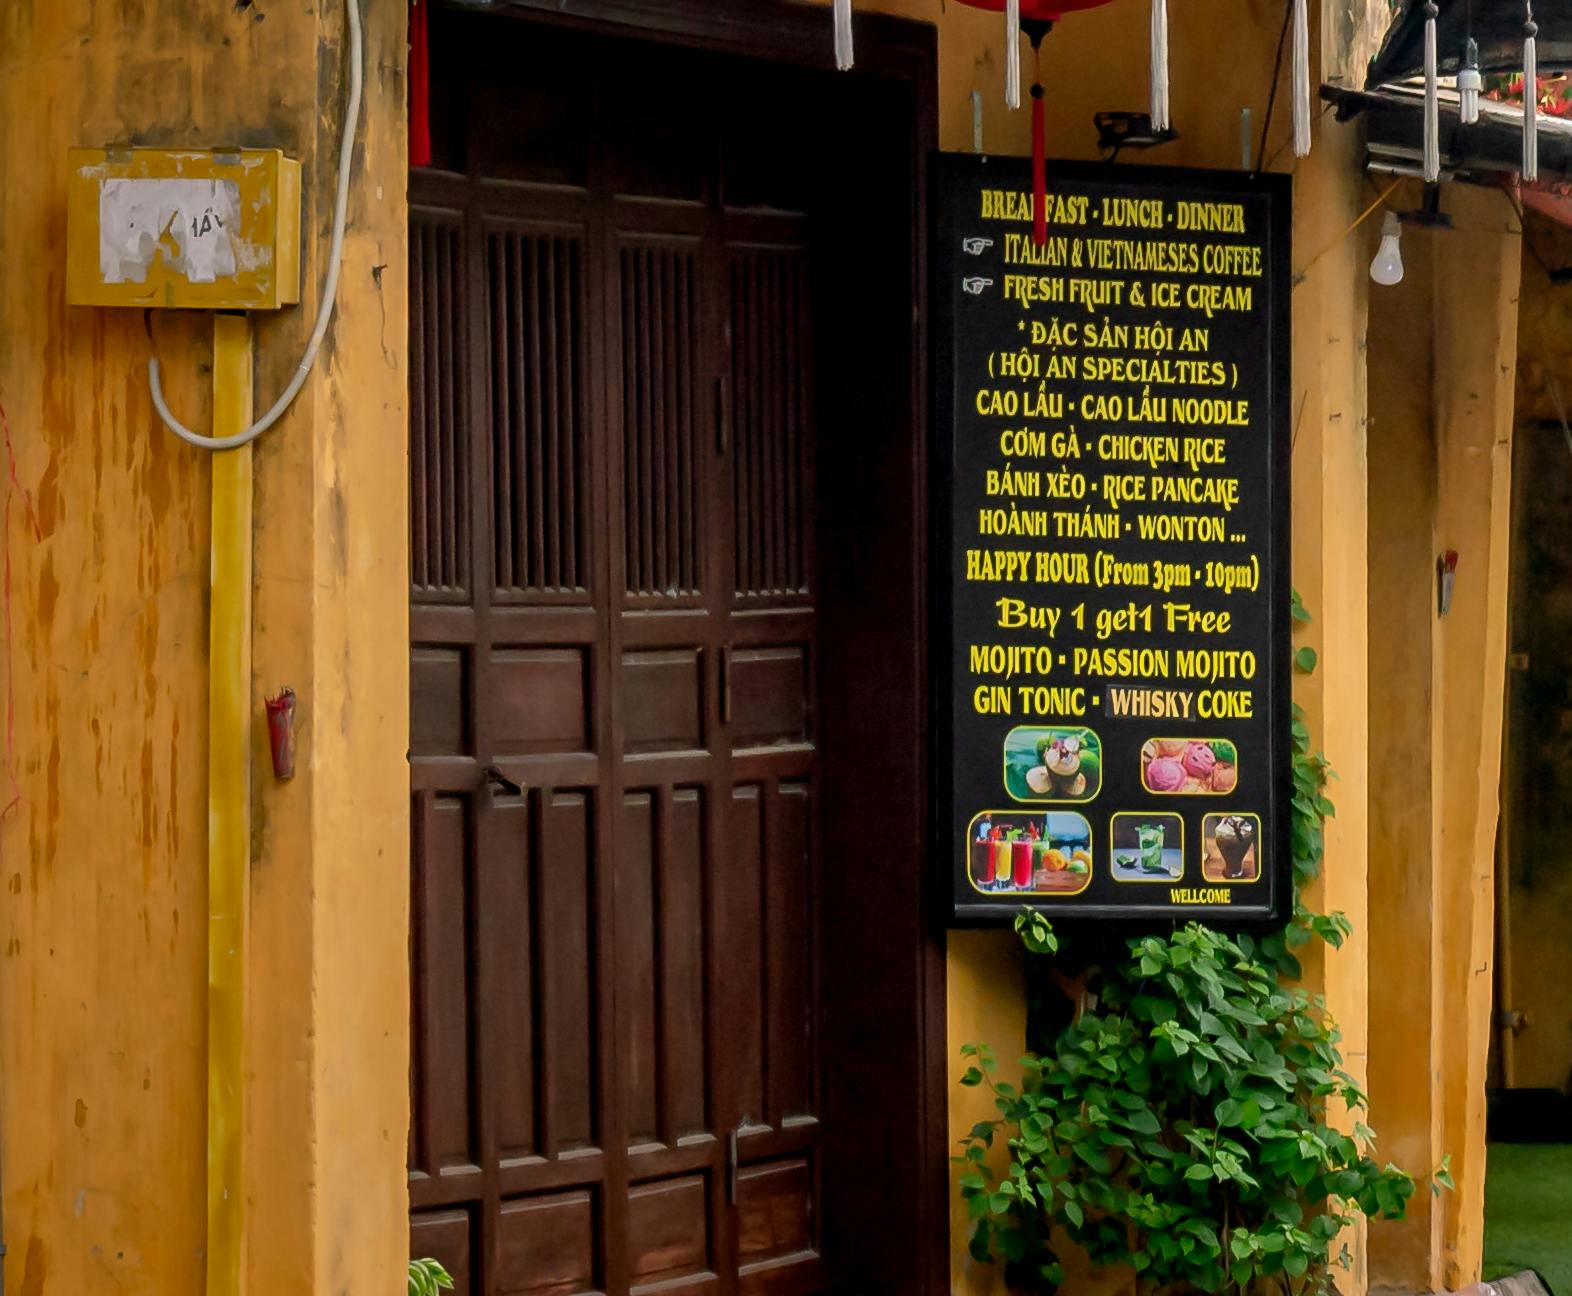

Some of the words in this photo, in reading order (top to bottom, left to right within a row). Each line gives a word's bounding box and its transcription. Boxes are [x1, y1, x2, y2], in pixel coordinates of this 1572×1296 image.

[982, 190, 1088, 224] BREAFAST
[1103, 198, 1163, 228] LUNCH
[1177, 202, 1245, 233] DINNER
[1005, 234, 1067, 266] ITALIAN
[1072, 240, 1082, 267] &
[1087, 239, 1199, 272] VIETNAMESES
[1203, 245, 1262, 276] COFFEE
[1005, 275, 1063, 308] FRESH
[1070, 279, 1124, 312] FRUIT
[1130, 282, 1145, 307] &
[1152, 283, 1180, 307] ICE
[1187, 285, 1251, 318] CREAM
[1135, 321, 1173, 355] HỘI
[1179, 329, 1208, 351] AN
[1001, 347, 1039, 382] HỘI
[1046, 355, 1076, 378] AN
[1083, 357, 1225, 387] SPECIALTIES
[977, 390, 1018, 416] CAO
[1081, 395, 1122, 421] CAO
[1173, 398, 1249, 425] NOODLE
[1001, 427, 1045, 457] CƠM
[1052, 425, 1080, 458] GÀ
[1098, 435, 1178, 469] CHICKEN
[1184, 438, 1225, 472] RICE
[987, 463, 1040, 496] BÁNH
[1047, 465, 1085, 499] XÈO
[1104, 475, 1146, 509] RICE
[1152, 477, 1239, 511] PANCAKE
[980, 502, 1047, 536] HOÀNH
[1053, 505, 1119, 539] THÁNH
[1138, 515, 1224, 542] WONTON
[967, 550, 1031, 581] HAPPY
[1036, 552, 1089, 584] HOUR
[1095, 550, 1149, 587] (From
[1153, 560, 1191, 593] 3pm
[1205, 555, 1259, 594] 10pm)
[996, 597, 1061, 638] Buy
[1163, 602, 1231, 633] Free
[971, 645, 1052, 680] MOJITO
[1074, 648, 1168, 678] PASSION
[1177, 650, 1255, 684] MOJITO
[974, 685, 1011, 715] GIN
[1019, 687, 1085, 716] TONIC
[1111, 689, 1193, 718] WHISKY
[1198, 690, 1253, 718] COKE
[1171, 889, 1230, 903] WELLCOME
